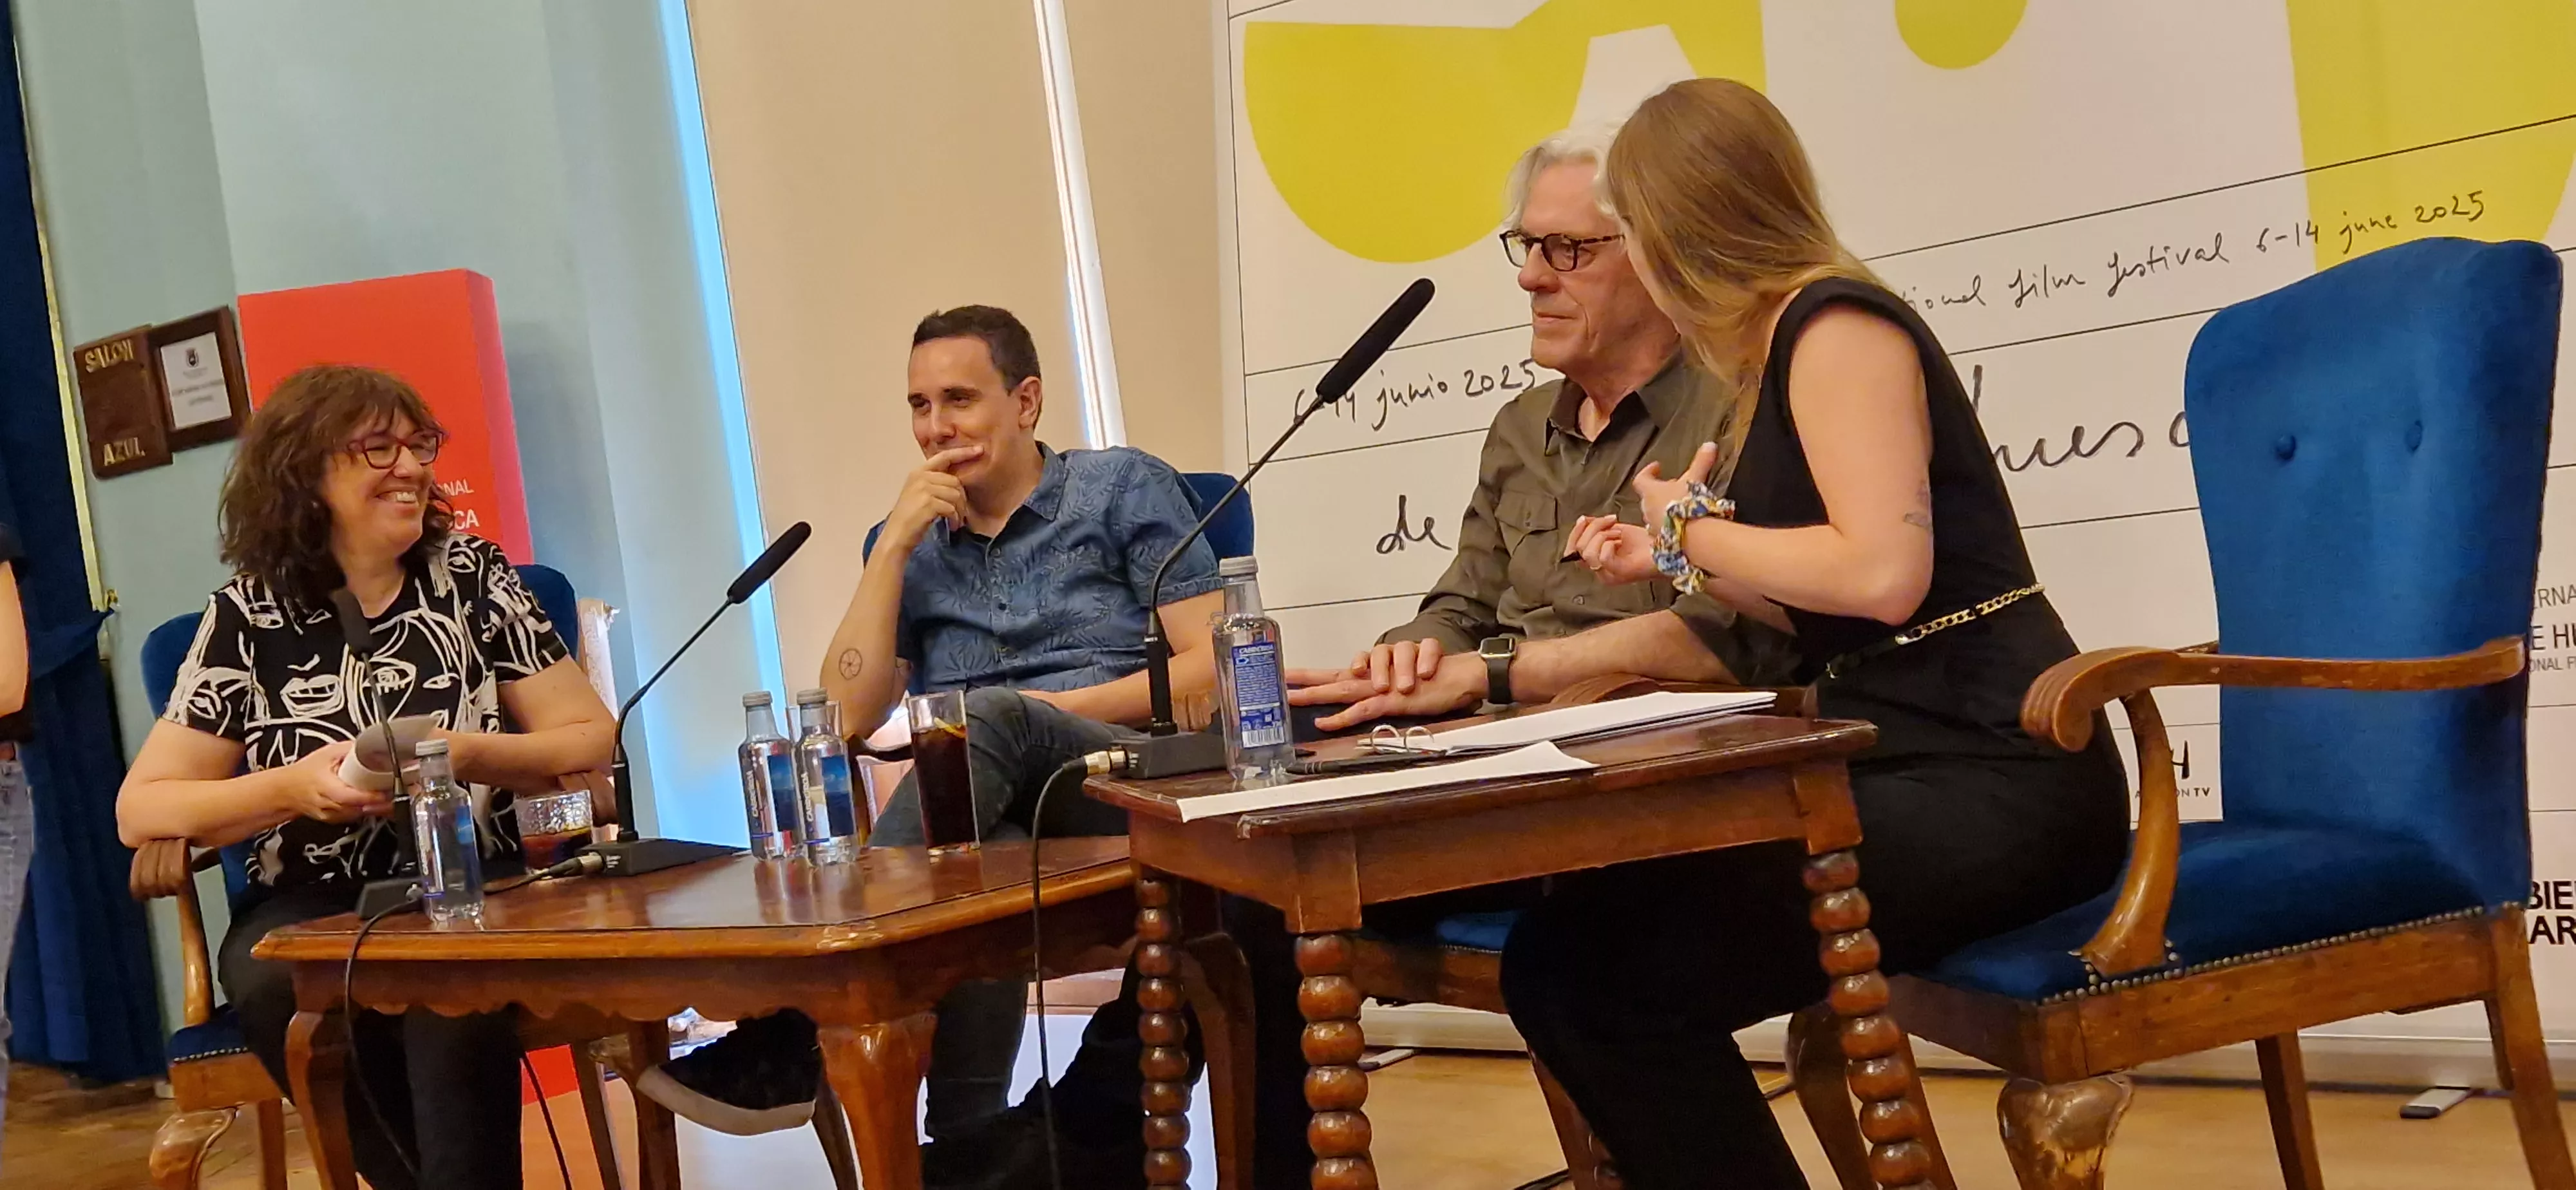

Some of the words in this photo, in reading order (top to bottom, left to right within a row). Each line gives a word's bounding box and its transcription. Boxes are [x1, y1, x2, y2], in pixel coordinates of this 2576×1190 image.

[1902, 275, 1986, 313] ional
[2009, 265, 2086, 308] film
[2108, 232, 2230, 298] festival
[2256, 220, 2319, 252] 6-14
[2339, 211, 2397, 254] june
[2415, 190, 2485, 223] 2025
[85, 339, 134, 373] SALON
[1372, 370, 1448, 431] junio
[1464, 358, 1535, 397] 2025
[103, 437, 146, 466] AZUL
[437, 478, 475, 496] NAL
[448, 509, 480, 530] CA
[1376, 494, 1453, 554] de
[2535, 583, 2576, 609] RNA
[2193, 787, 2211, 797] TV
[2528, 880, 2576, 910] BIE
